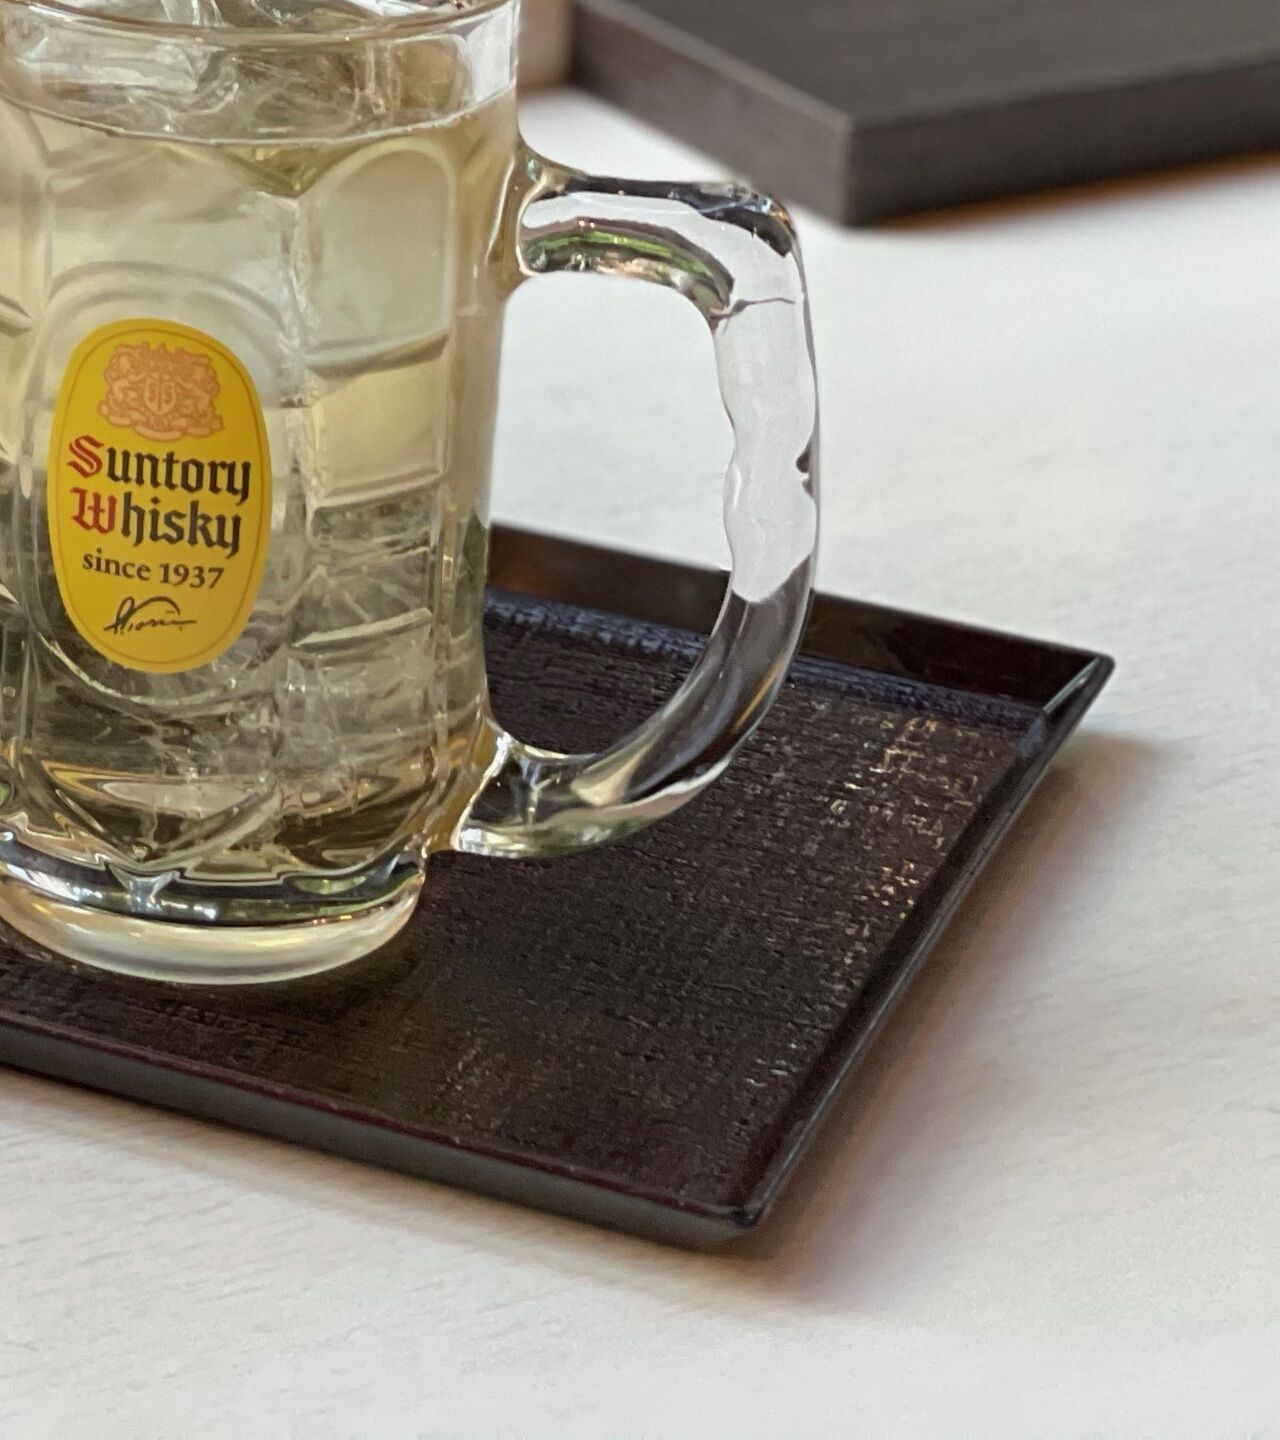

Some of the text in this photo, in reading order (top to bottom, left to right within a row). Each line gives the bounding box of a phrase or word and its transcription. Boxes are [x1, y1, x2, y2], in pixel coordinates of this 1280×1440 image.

[67, 435, 252, 506] Suntory
[70, 486, 242, 559] Whisky
[82, 547, 226, 590] since 1937
